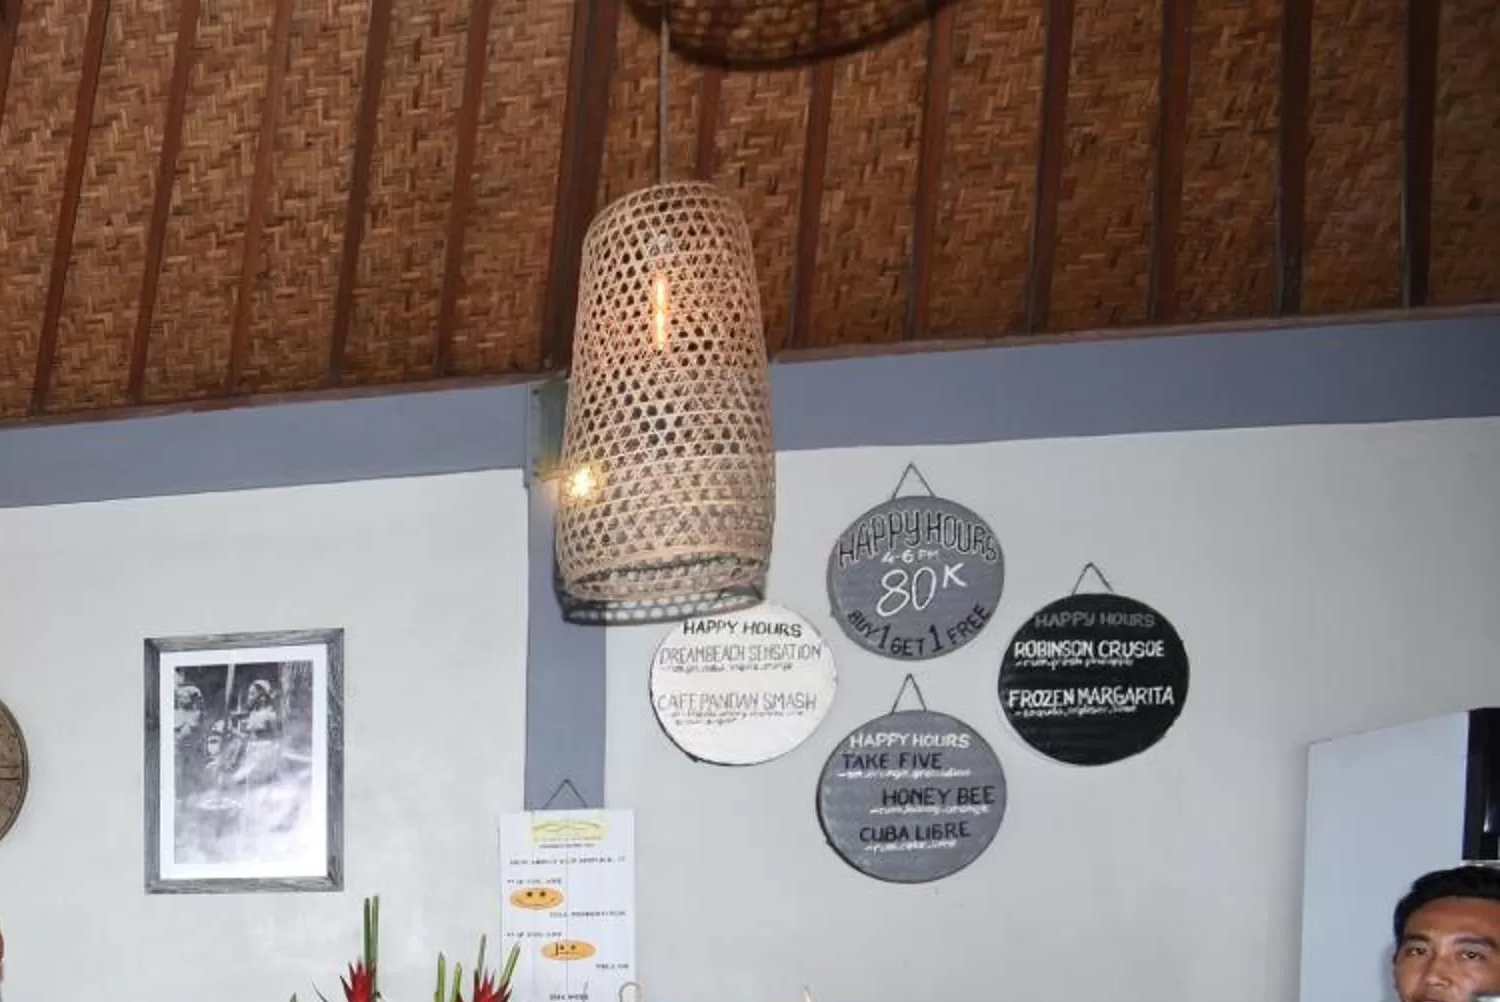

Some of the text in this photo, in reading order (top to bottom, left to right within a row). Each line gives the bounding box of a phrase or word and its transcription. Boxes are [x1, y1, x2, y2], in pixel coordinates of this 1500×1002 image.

[838, 509, 998, 568] HAPPY HOURS
[683, 619, 803, 638] HAPPY HOURS
[847, 603, 991, 656] BUY 1 GET 1 FREE
[1033, 611, 1156, 628] HAPPY HOURS
[750, 643, 822, 662] SENSATION
[1013, 639, 1165, 659] ROBINSON CRUSOE
[763, 691, 817, 711] SMASH
[1008, 685, 1175, 708] FROZEN MARGARITA
[850, 732, 971, 749] HAPPY HOURS
[842, 751, 944, 770] TAKE FIVE
[882, 785, 997, 806] HONEY BEE
[858, 820, 972, 843] CUBA LIBRE
